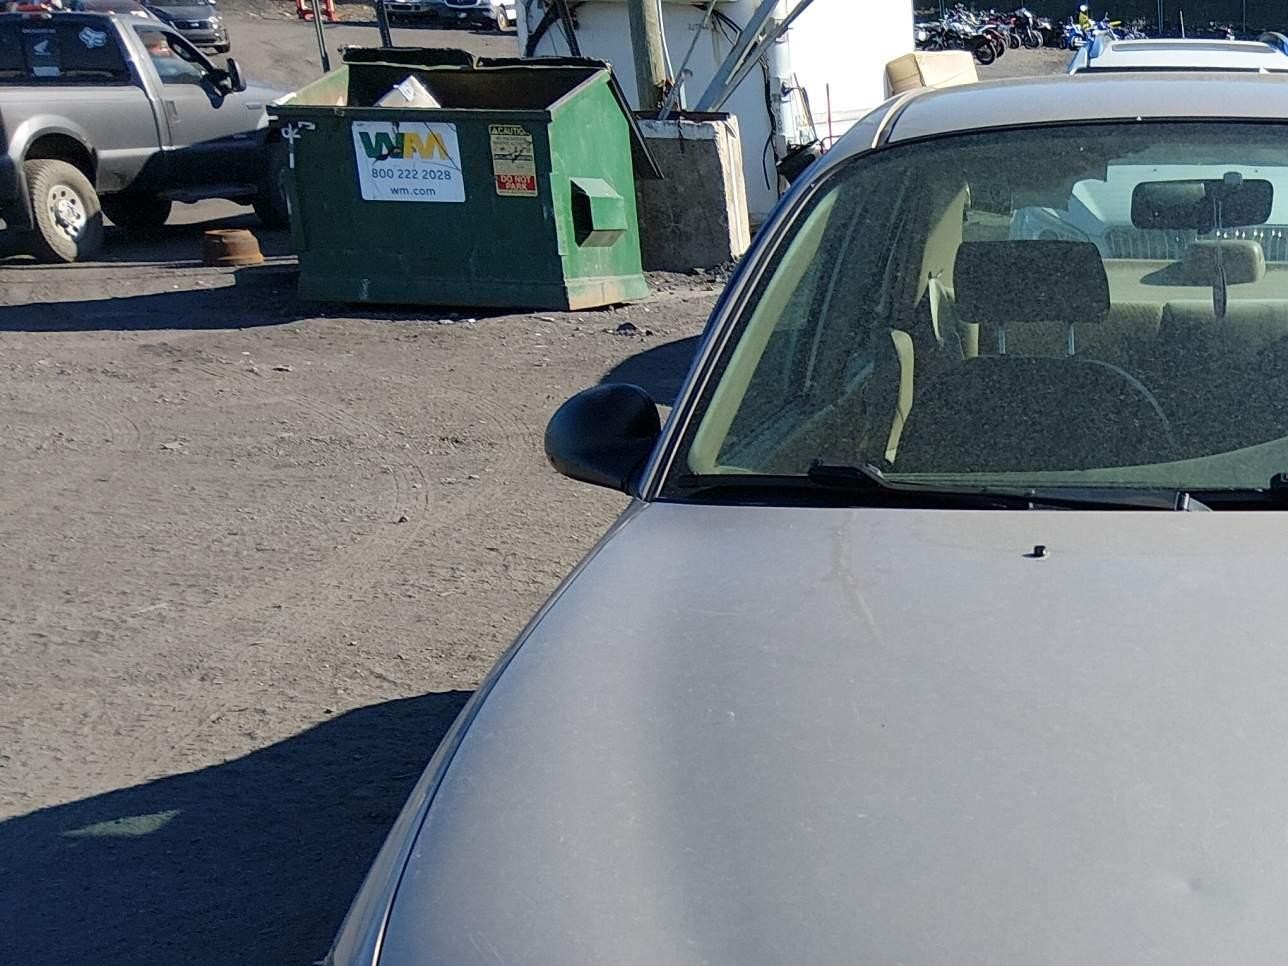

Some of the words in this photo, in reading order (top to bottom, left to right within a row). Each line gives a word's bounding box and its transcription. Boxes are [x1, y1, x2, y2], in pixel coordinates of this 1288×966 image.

[359, 131, 447, 160] WM
[371, 168, 394, 179] 800
[398, 169, 419, 179] 222
[422, 169, 452, 180] 2028
[515, 175, 531, 183] NOT
[390, 186, 436, 196] wm.com
